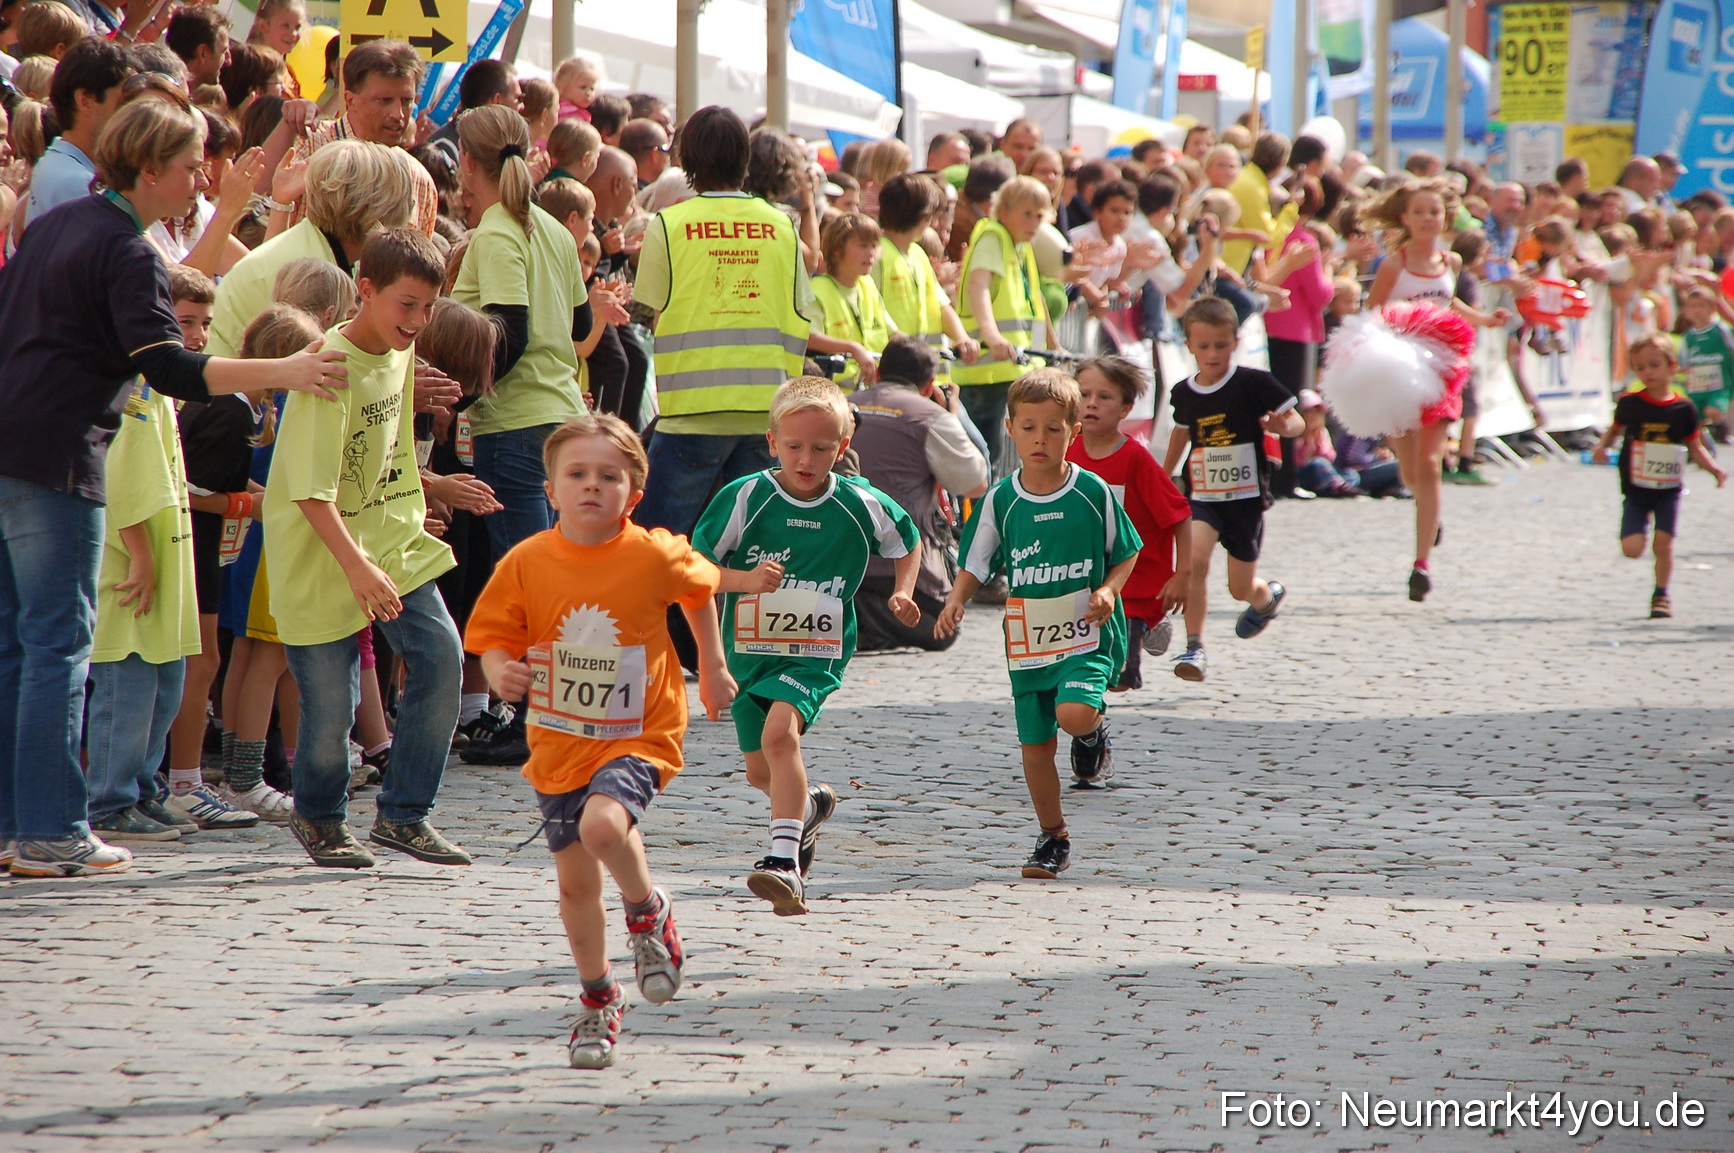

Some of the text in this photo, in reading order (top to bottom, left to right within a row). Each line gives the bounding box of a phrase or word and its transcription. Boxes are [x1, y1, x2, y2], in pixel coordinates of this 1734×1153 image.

[440, 24, 500, 111] wwwi-dsl.de
[685, 222, 777, 240] HELFER
[708, 249, 759, 257] NEUMARKTER
[717, 257, 759, 265] STADTLAUF
[361, 394, 402, 417] NEUMAR
[460, 426, 470, 437] K3
[1207, 452, 1232, 463] Jonas
[1208, 465, 1251, 483] 7096
[786, 518, 821, 530] DERBYSTAR
[1033, 511, 1064, 523] DERBYSTAR
[226, 525, 237, 536] K3
[745, 545, 791, 565] Sport
[1010, 539, 1042, 567] Sport
[1011, 558, 1094, 588] Münch
[778, 573, 847, 599] ünch
[766, 612, 833, 633] 7246
[1032, 618, 1091, 645] 7239
[800, 644, 840, 653] PFLEIDERER
[558, 649, 616, 672] Vinzenz
[533, 669, 547, 684] K2
[778, 673, 811, 698] DERBYSTAR
[560, 677, 631, 709] 7071
[1064, 680, 1094, 692] DERBYSTAR
[596, 724, 641, 733] PFLEIDERER
